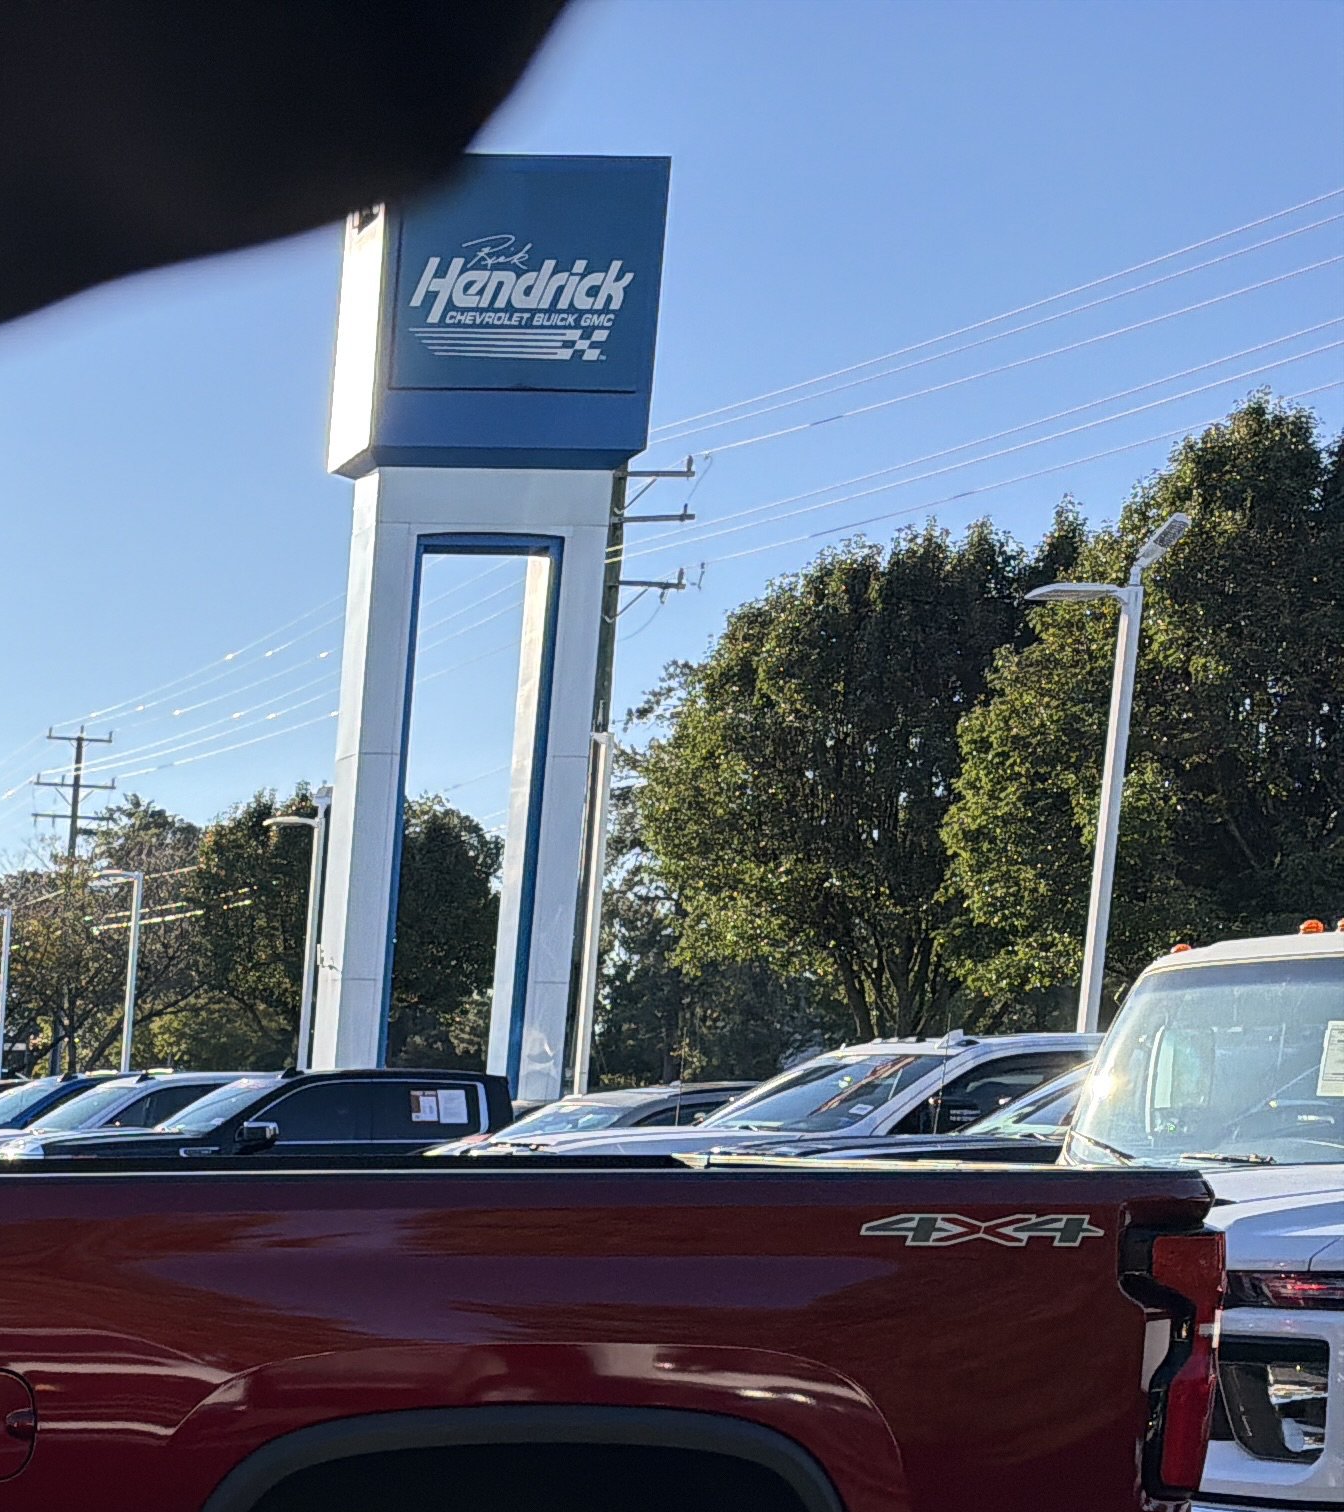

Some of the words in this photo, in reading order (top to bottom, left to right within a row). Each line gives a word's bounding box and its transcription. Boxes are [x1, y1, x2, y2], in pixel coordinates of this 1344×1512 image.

[409, 257, 634, 323] Hendrick
[445, 311, 531, 326] CHEVROLET
[532, 313, 579, 327] BUICK
[580, 313, 615, 328] GMC
